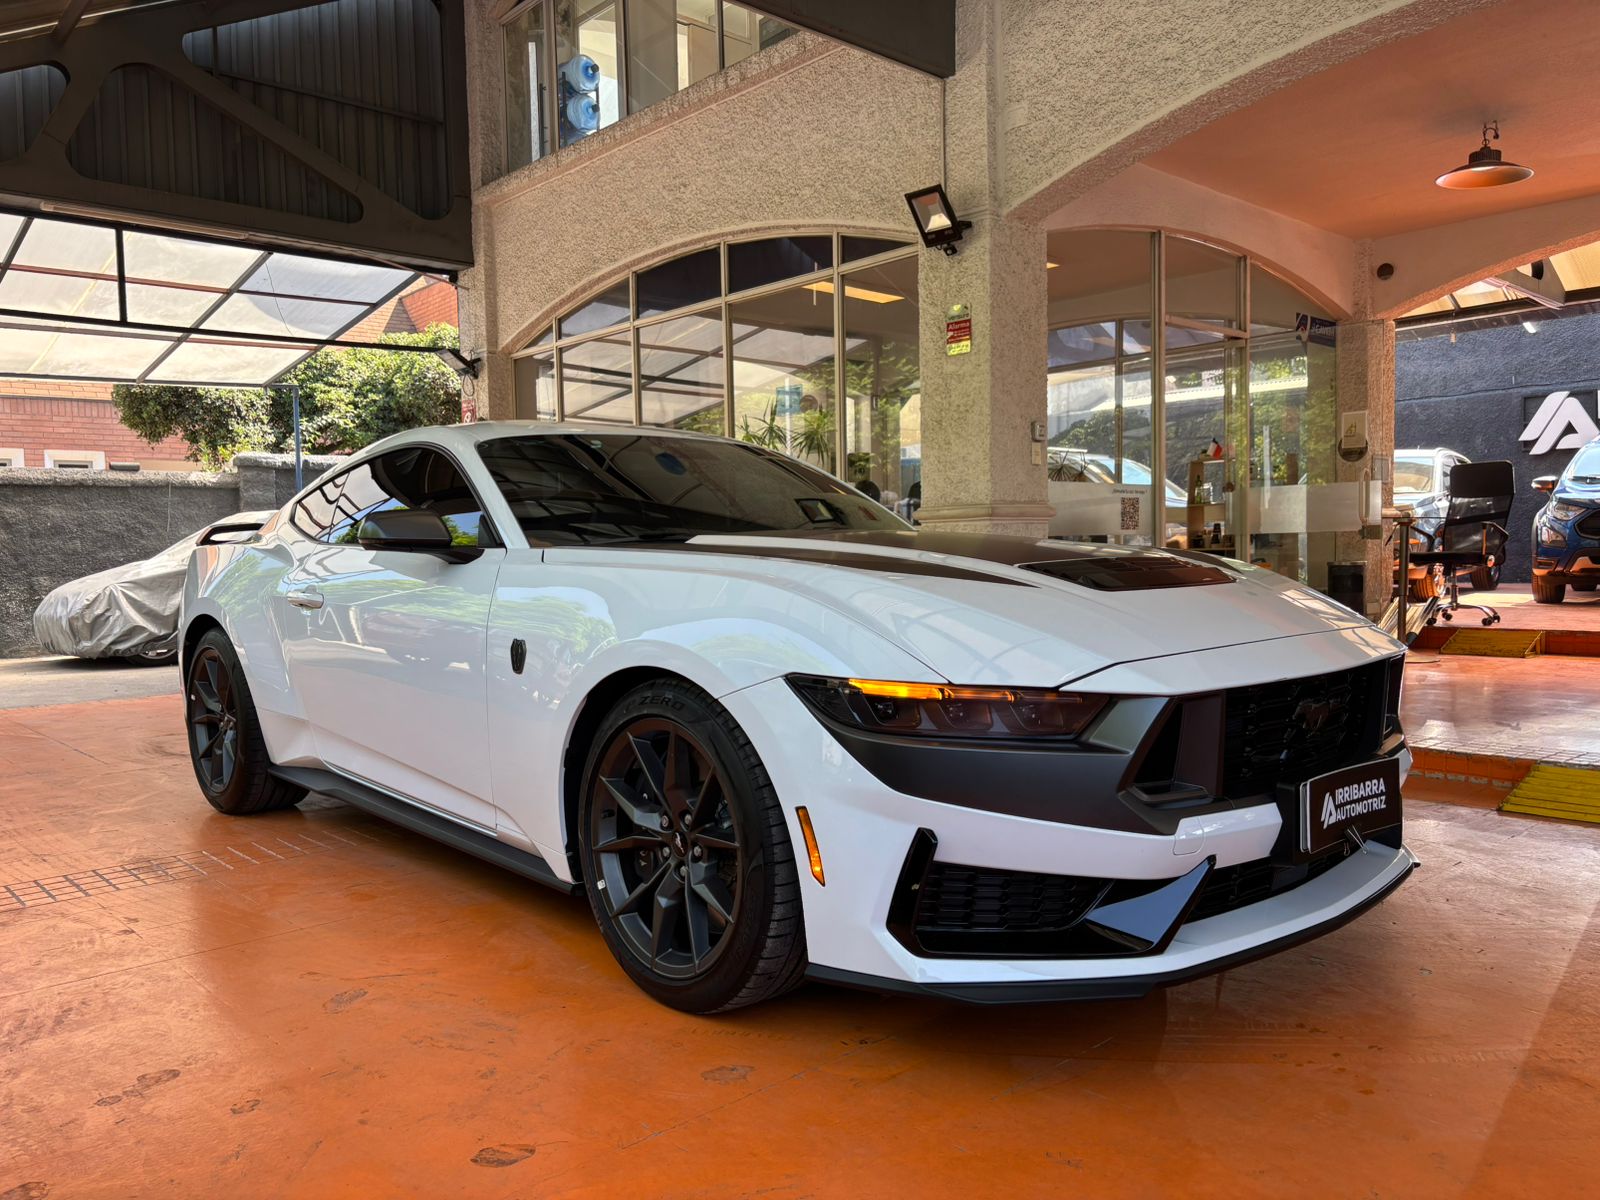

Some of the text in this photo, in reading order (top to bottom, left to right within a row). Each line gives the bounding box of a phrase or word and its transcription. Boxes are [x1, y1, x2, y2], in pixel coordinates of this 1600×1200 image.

[638, 695, 686, 711] ZERO
[1335, 777, 1386, 805] IRRIBARRA
[1336, 795, 1387, 822] AUTOMOTRIZ
